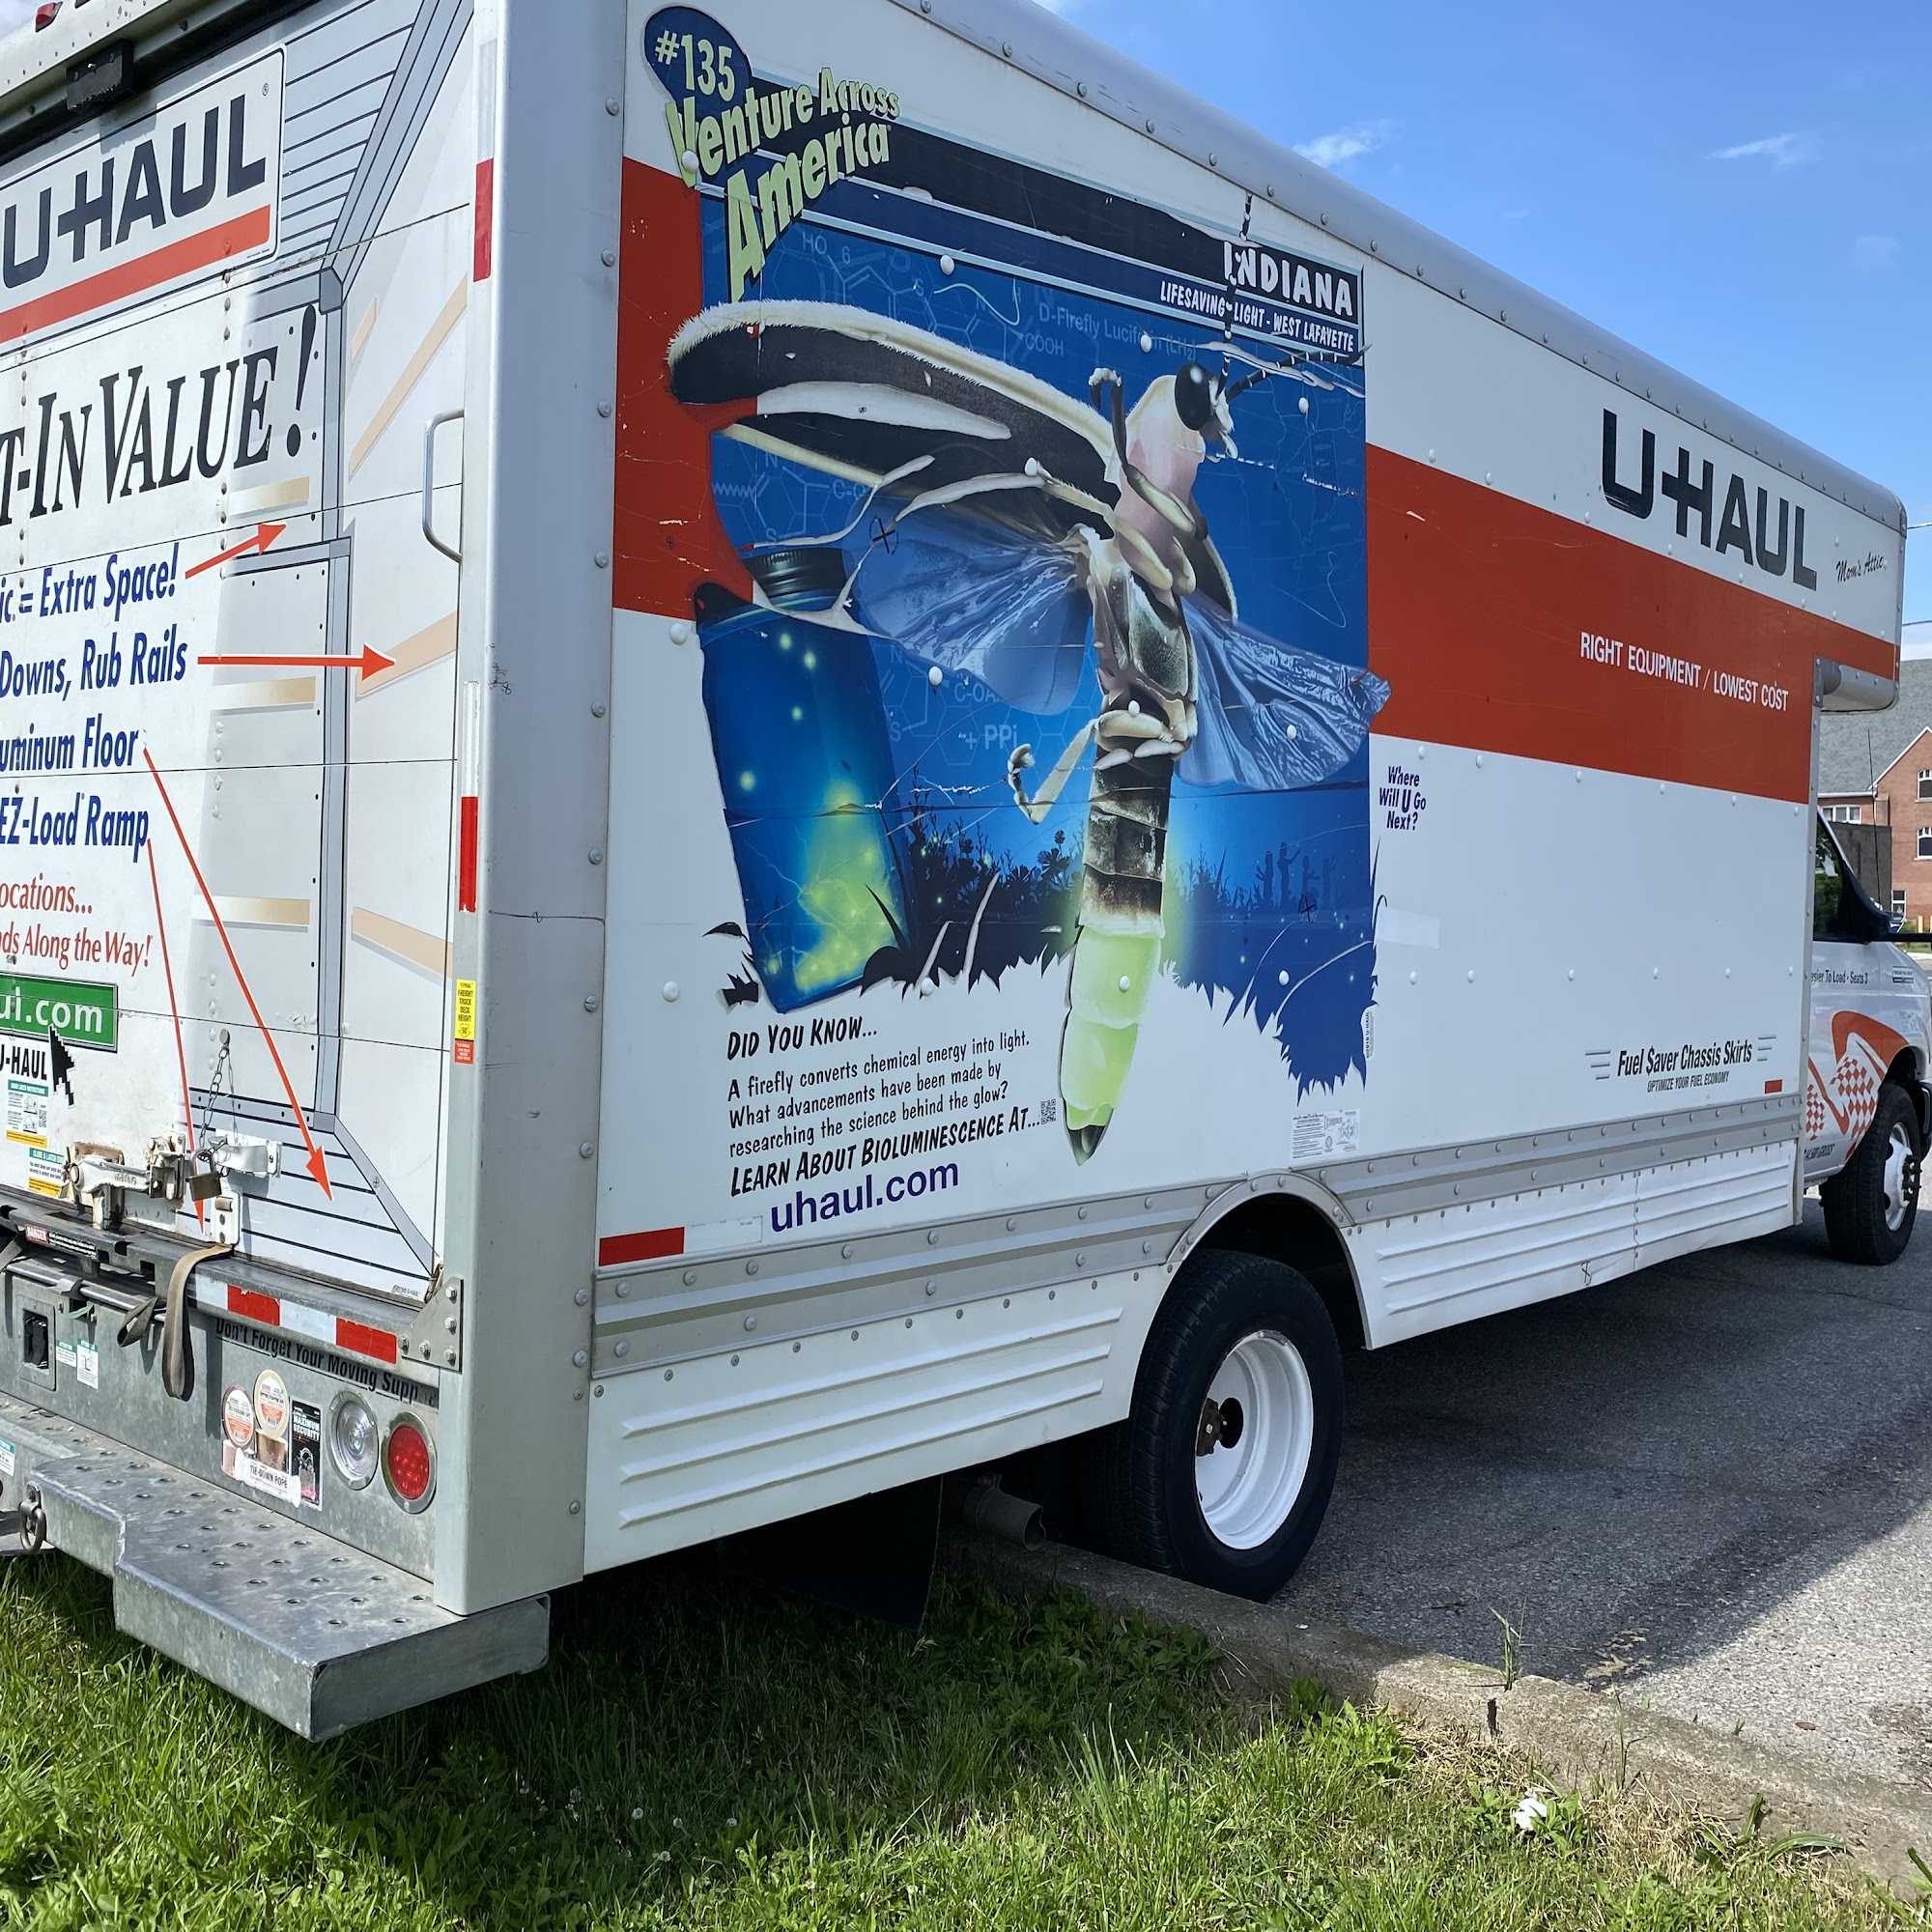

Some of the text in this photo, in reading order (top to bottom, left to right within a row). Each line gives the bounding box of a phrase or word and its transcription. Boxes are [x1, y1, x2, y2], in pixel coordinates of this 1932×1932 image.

[655, 30, 735, 101] #135
[665, 67, 900, 188] Venture Across
[2, 94, 266, 290] U-HAUL
[726, 112, 891, 302] America
[1223, 242, 1353, 317] INDIANA
[1038, 302, 1100, 337] D-Firefly
[1104, 318, 1162, 350] Lucifin
[1160, 280, 1226, 317] LIFESAVING
[1234, 301, 1265, 327] LIGHT
[1273, 313, 1301, 337] WEST
[1304, 322, 1354, 354] LAFAYETTE
[99, 305, 316, 503] VALUE!
[1602, 409, 1817, 591] U-HAUL
[40, 567, 97, 617] Extra
[103, 542, 179, 622] Space!
[1835, 559, 1861, 583] Mom's
[0, 623, 187, 701] Downs, Rub Rails
[1580, 631, 1623, 668] RIGHT
[1628, 645, 1701, 690] EQUIPMENT
[1714, 670, 1758, 705] LOWEST
[1761, 685, 1788, 712] COST
[82, 713, 139, 769] Floor
[1378, 787, 1427, 813] Will U Go
[1388, 766, 1420, 787] Where
[84, 795, 149, 863] Ramp
[1386, 810, 1418, 831] Next?
[22, 923, 71, 970] Along
[74, 927, 101, 962] the
[104, 931, 152, 977] Way!
[1826, 970, 1832, 982] To
[1833, 971, 1846, 983] Load
[1850, 972, 1864, 984] Seats
[727, 1015, 877, 1061] DID YOU KNOW...
[727, 1029, 1030, 1101] A firefly converts chemical energy into light.
[1617, 1048, 1644, 1076] Fuel
[1681, 1042, 1720, 1070] Chassis
[1723, 1039, 1752, 1065] Skirts
[729, 1059, 1001, 1128] What advancements have been made by
[1647, 1070, 1730, 1093] OPTIMIZE YOUR FUEL ECONOMY
[729, 1080, 1009, 1158] researching the science behind the glow?
[730, 1157, 790, 1198] LEARN
[796, 1144, 857, 1181] ABOUT
[862, 1113, 1004, 1167] BIOLUMINESCENCE
[771, 1162, 959, 1233] uhaul.com
[215, 1318, 248, 1344] Don't
[251, 1329, 291, 1358] Forget
[295, 1343, 324, 1367] Your
[327, 1353, 377, 1392] Moving
[294, 1415, 320, 1431] MAXIMUM
[294, 1425, 320, 1442] SECURITY
[274, 1473, 288, 1489] ROPE
